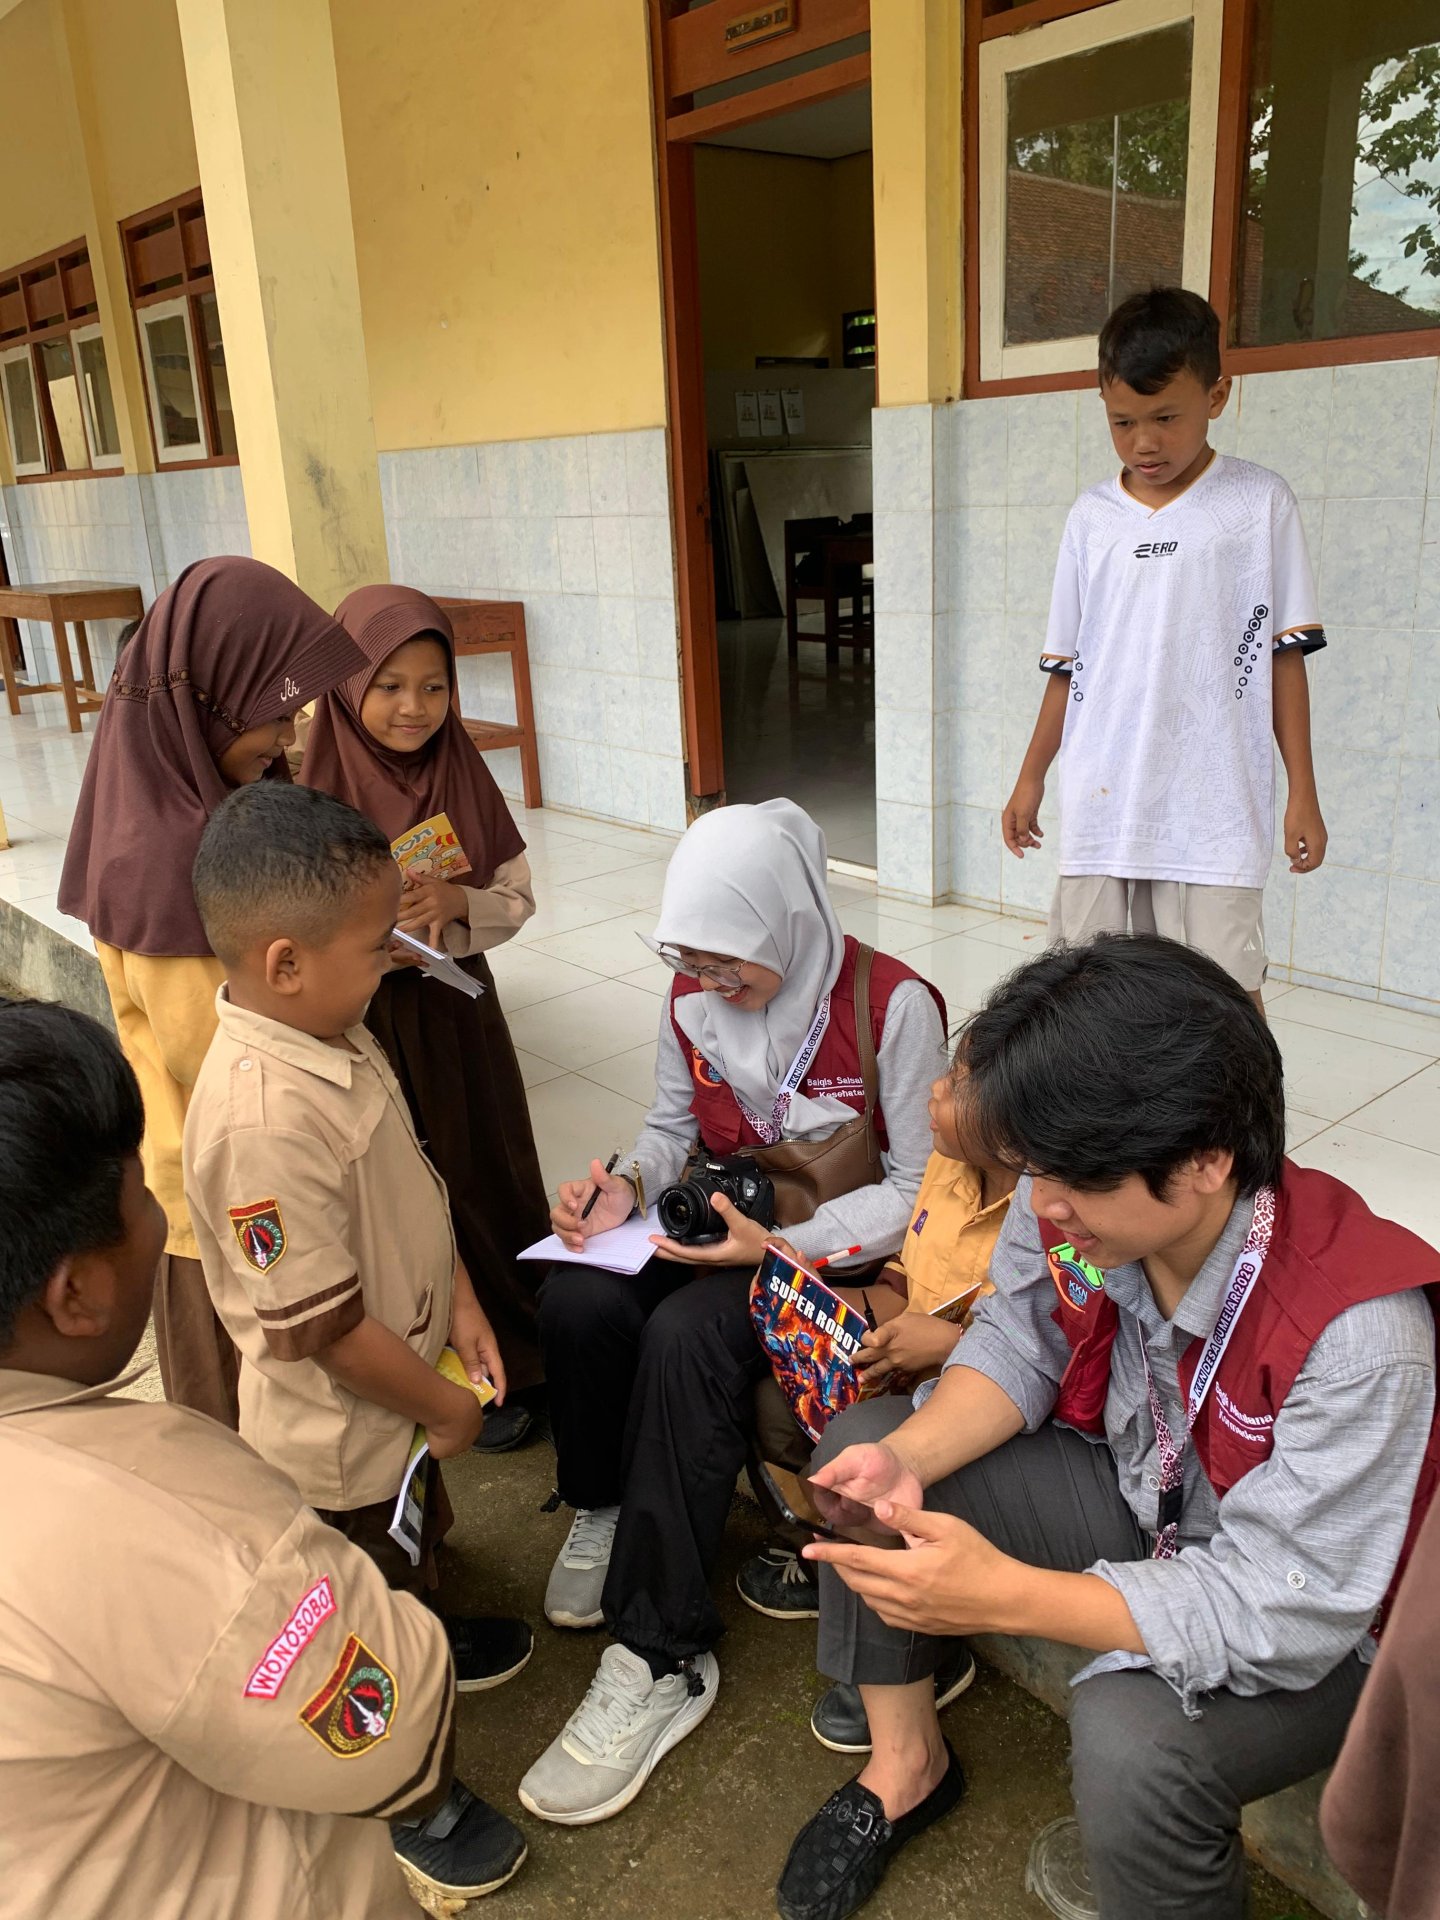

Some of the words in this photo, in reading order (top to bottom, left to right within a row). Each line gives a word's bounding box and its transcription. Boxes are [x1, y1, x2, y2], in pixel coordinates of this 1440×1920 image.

[787, 1068, 803, 1089] KKN
[796, 1047, 813, 1070] DESA
[808, 1004, 829, 1047] GUMELAR
[769, 1275, 816, 1320] SUPER
[815, 1309, 862, 1355] ROBOT
[1068, 1280, 1088, 1300] KKN
[1193, 1367, 1209, 1398] KKN
[1201, 1342, 1221, 1376] DESA
[1213, 1291, 1243, 1346] GUMELAR
[1232, 1262, 1256, 1297] 2026
[252, 1589, 331, 1690] WONOSOBO
[630, 1709, 655, 1735] Reeb
